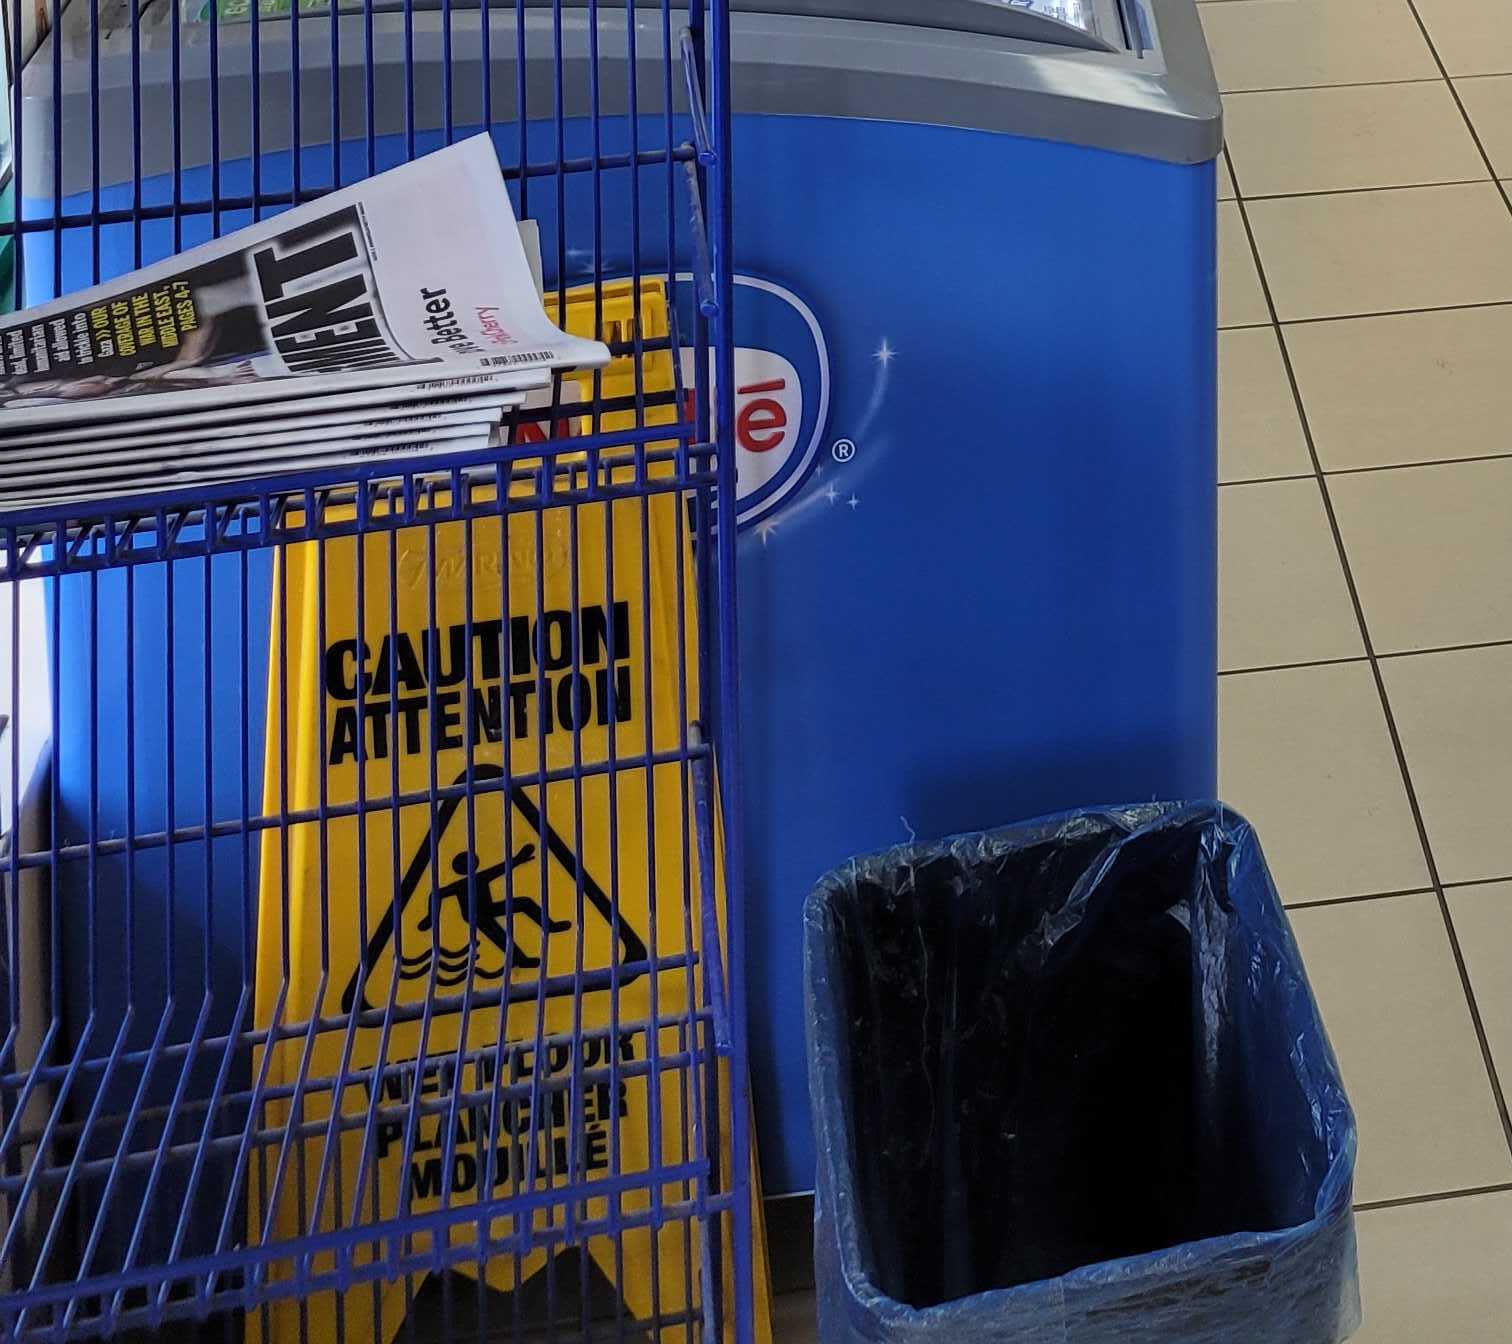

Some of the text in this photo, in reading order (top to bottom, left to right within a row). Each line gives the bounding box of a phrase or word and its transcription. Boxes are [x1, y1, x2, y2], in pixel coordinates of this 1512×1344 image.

[91, 305, 111, 329] OUR
[132, 292, 157, 347] WAR THE
[153, 285, 174, 316] EAST,
[172, 281, 198, 332] PAGES 4-7
[420, 287, 459, 345] Better
[112, 301, 137, 357] COVERAGE OF
[325, 600, 631, 701] CAUTION
[328, 665, 633, 765] ATTENTION
